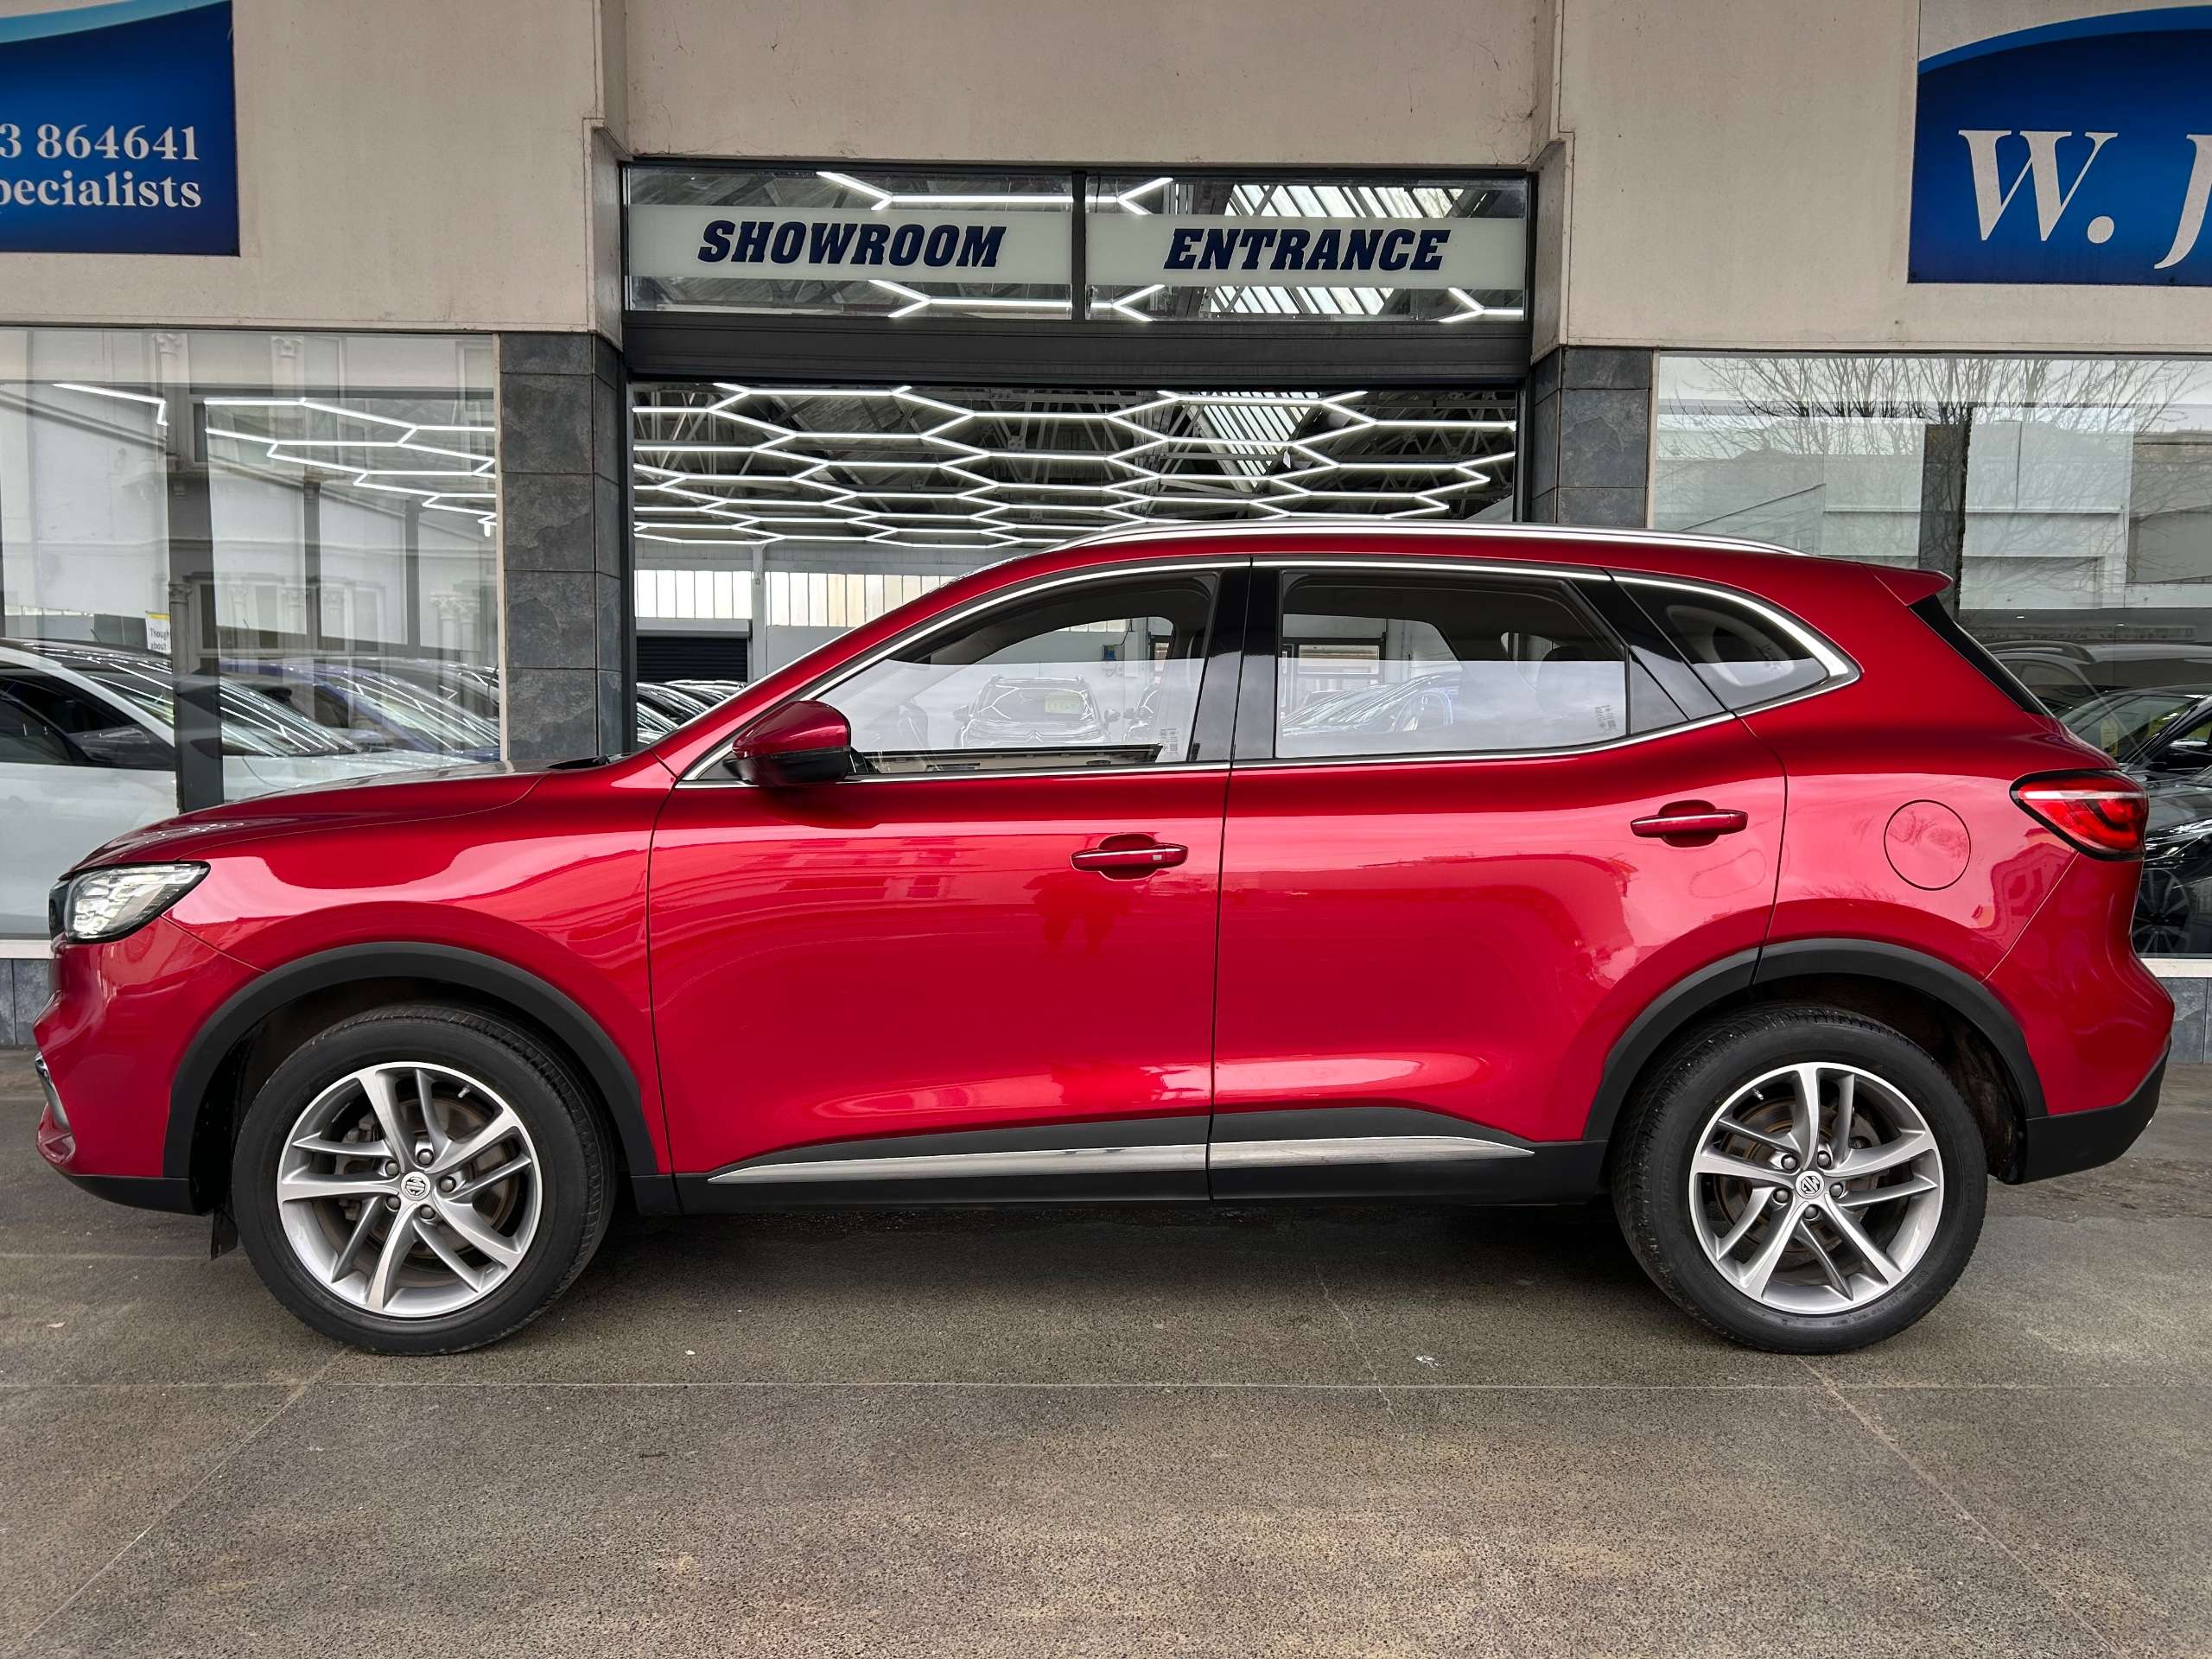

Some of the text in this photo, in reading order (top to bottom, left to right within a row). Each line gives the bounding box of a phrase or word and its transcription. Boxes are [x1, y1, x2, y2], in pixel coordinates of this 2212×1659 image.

[0, 123, 200, 161] 3 864641
[1957, 129, 2120, 245] W.
[696, 219, 1452, 272] SHOWROOM ENTRANCE
